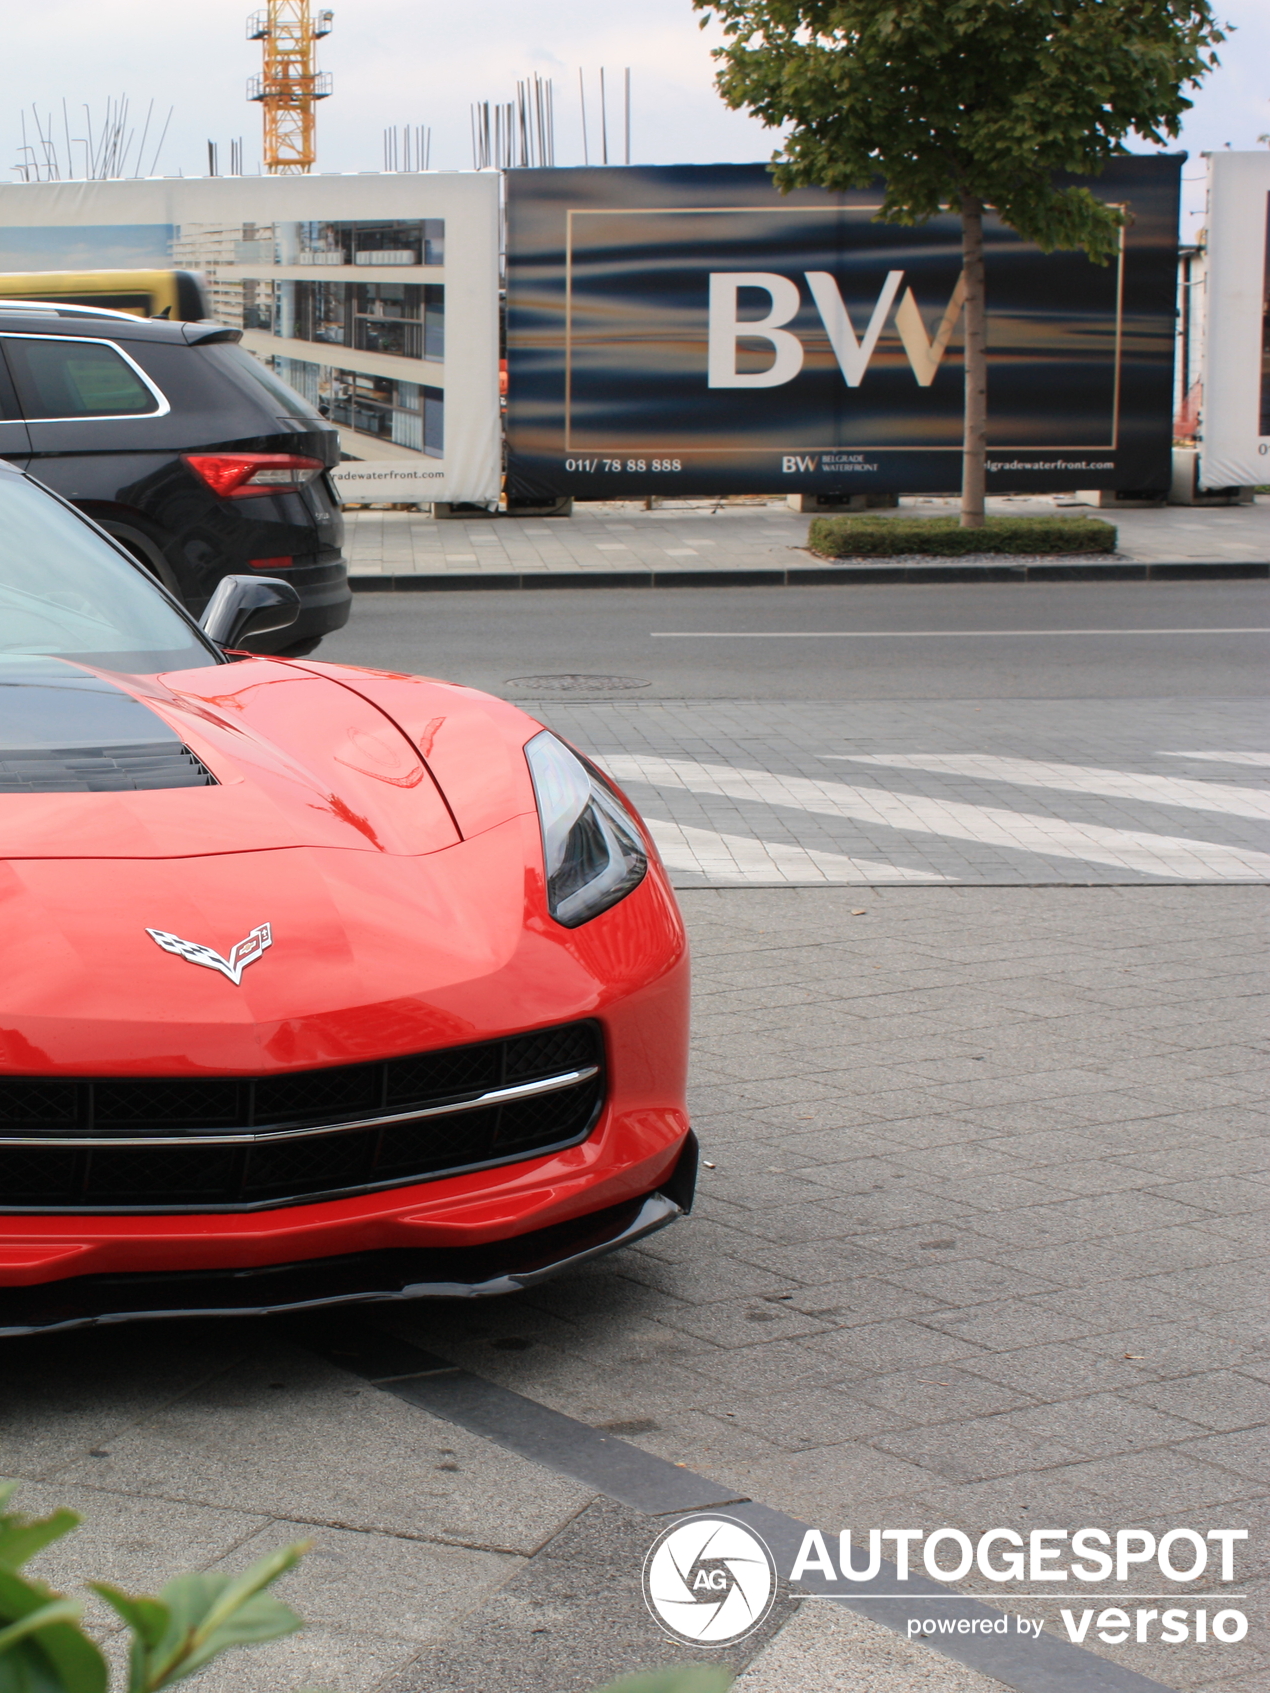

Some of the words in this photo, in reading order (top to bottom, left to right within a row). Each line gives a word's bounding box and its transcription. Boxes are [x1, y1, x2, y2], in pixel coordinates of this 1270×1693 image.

[708, 270, 966, 388] BW
[782, 456, 819, 473] BW
[822, 455, 865, 463] BELGRADE
[565, 458, 598, 473] 011/
[602, 459, 621, 472] 78
[627, 459, 647, 472] 88
[652, 459, 682, 472] 888
[822, 463, 879, 472] WATERFRONT
[332, 470, 444, 480] radewaterfront.com
